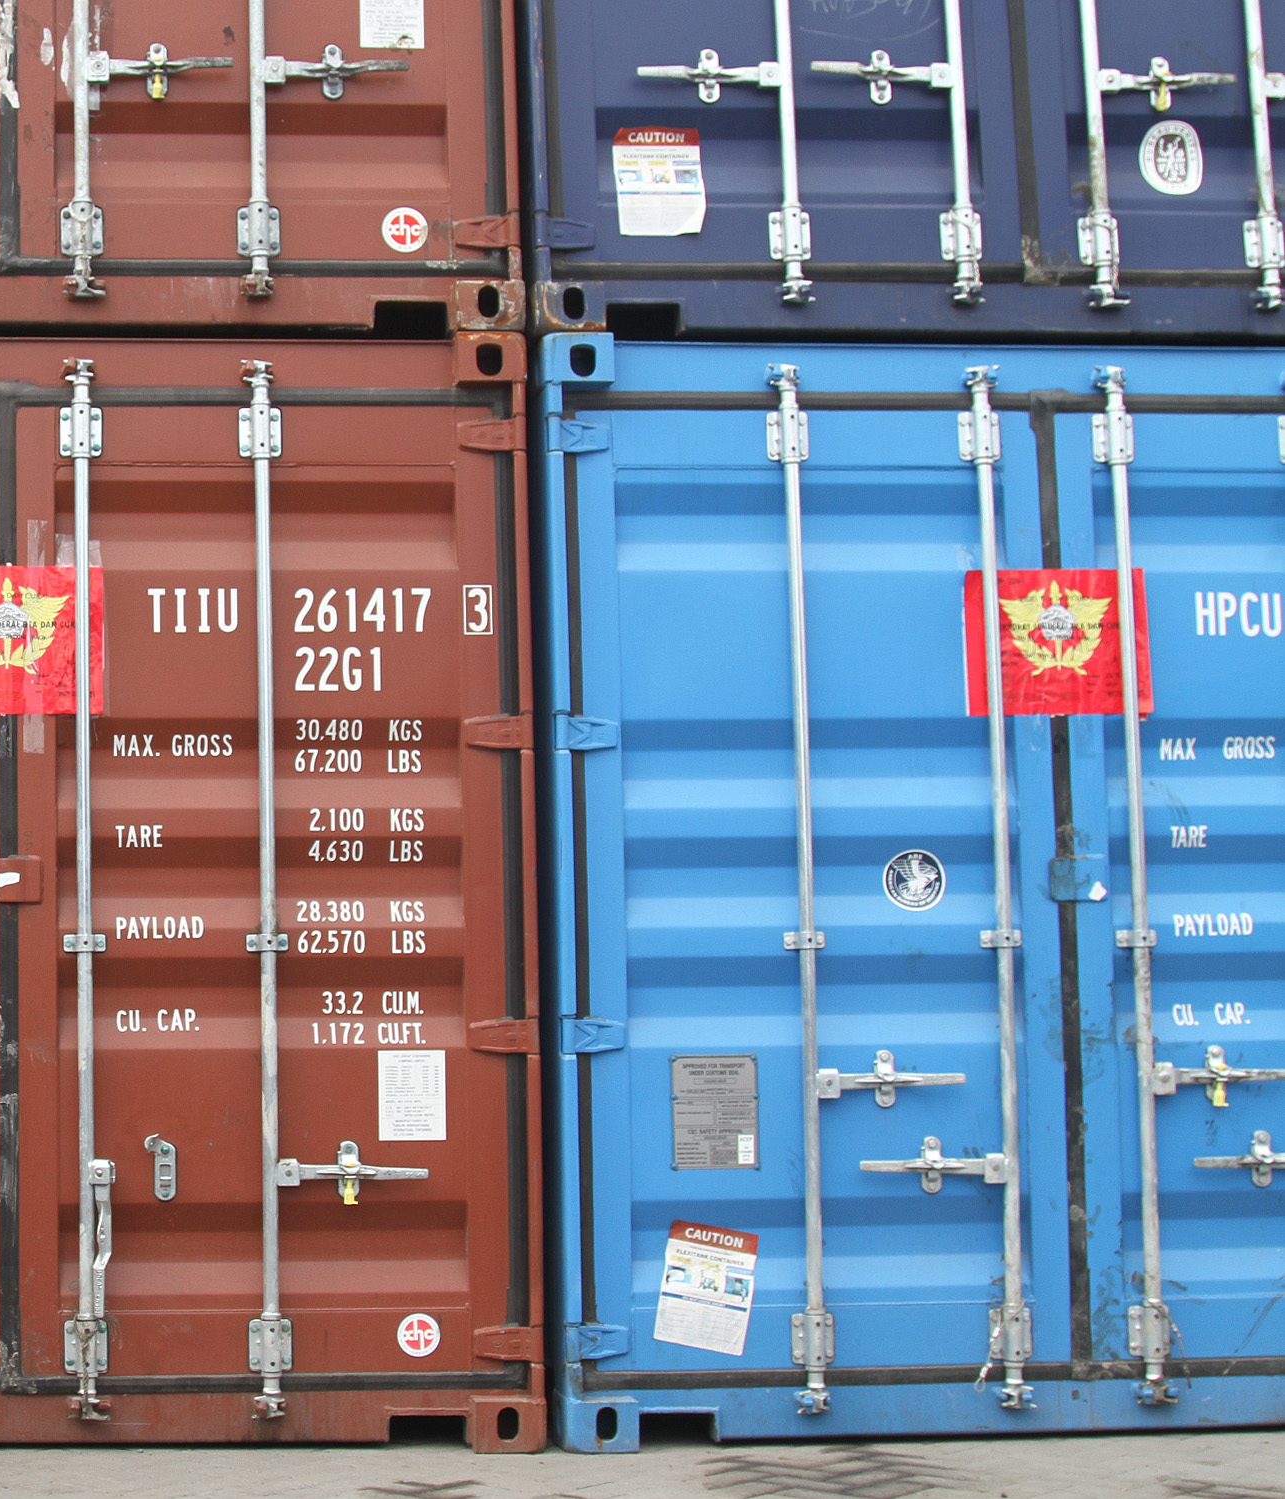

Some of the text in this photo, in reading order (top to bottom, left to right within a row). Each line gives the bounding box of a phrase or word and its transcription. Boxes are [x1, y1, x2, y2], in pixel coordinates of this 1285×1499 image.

[628, 132, 685, 143] CAUTION
[148, 587, 491, 634] TIIU 261417 3
[1194, 591, 1282, 638] HPCU
[295, 646, 383, 692] 22G1
[295, 719, 423, 741] 30,480 KGS
[113, 734, 233, 757] MAX. GROSS
[1160, 737, 1275, 761] MAX GROSS
[294, 749, 422, 773] 67,200 LBS
[309, 808, 425, 832] 2,100 KGS
[115, 825, 163, 848] TARE
[1170, 826, 1208, 849] TARE
[308, 839, 424, 862] 4,630 LBS
[296, 900, 425, 924] 28,380 KGS
[115, 916, 205, 940] PAYLOAD
[1173, 913, 1254, 938] PAYLOAD
[297, 930, 426, 955] 62,570 LBS
[322, 991, 364, 1015] 33.2
[1172, 1003, 1251, 1027] CU. CAP.
[116, 1009, 200, 1033] CU. CAP.
[312, 1022, 366, 1046] 1,172
[685, 1228, 744, 1248] CAUTION
